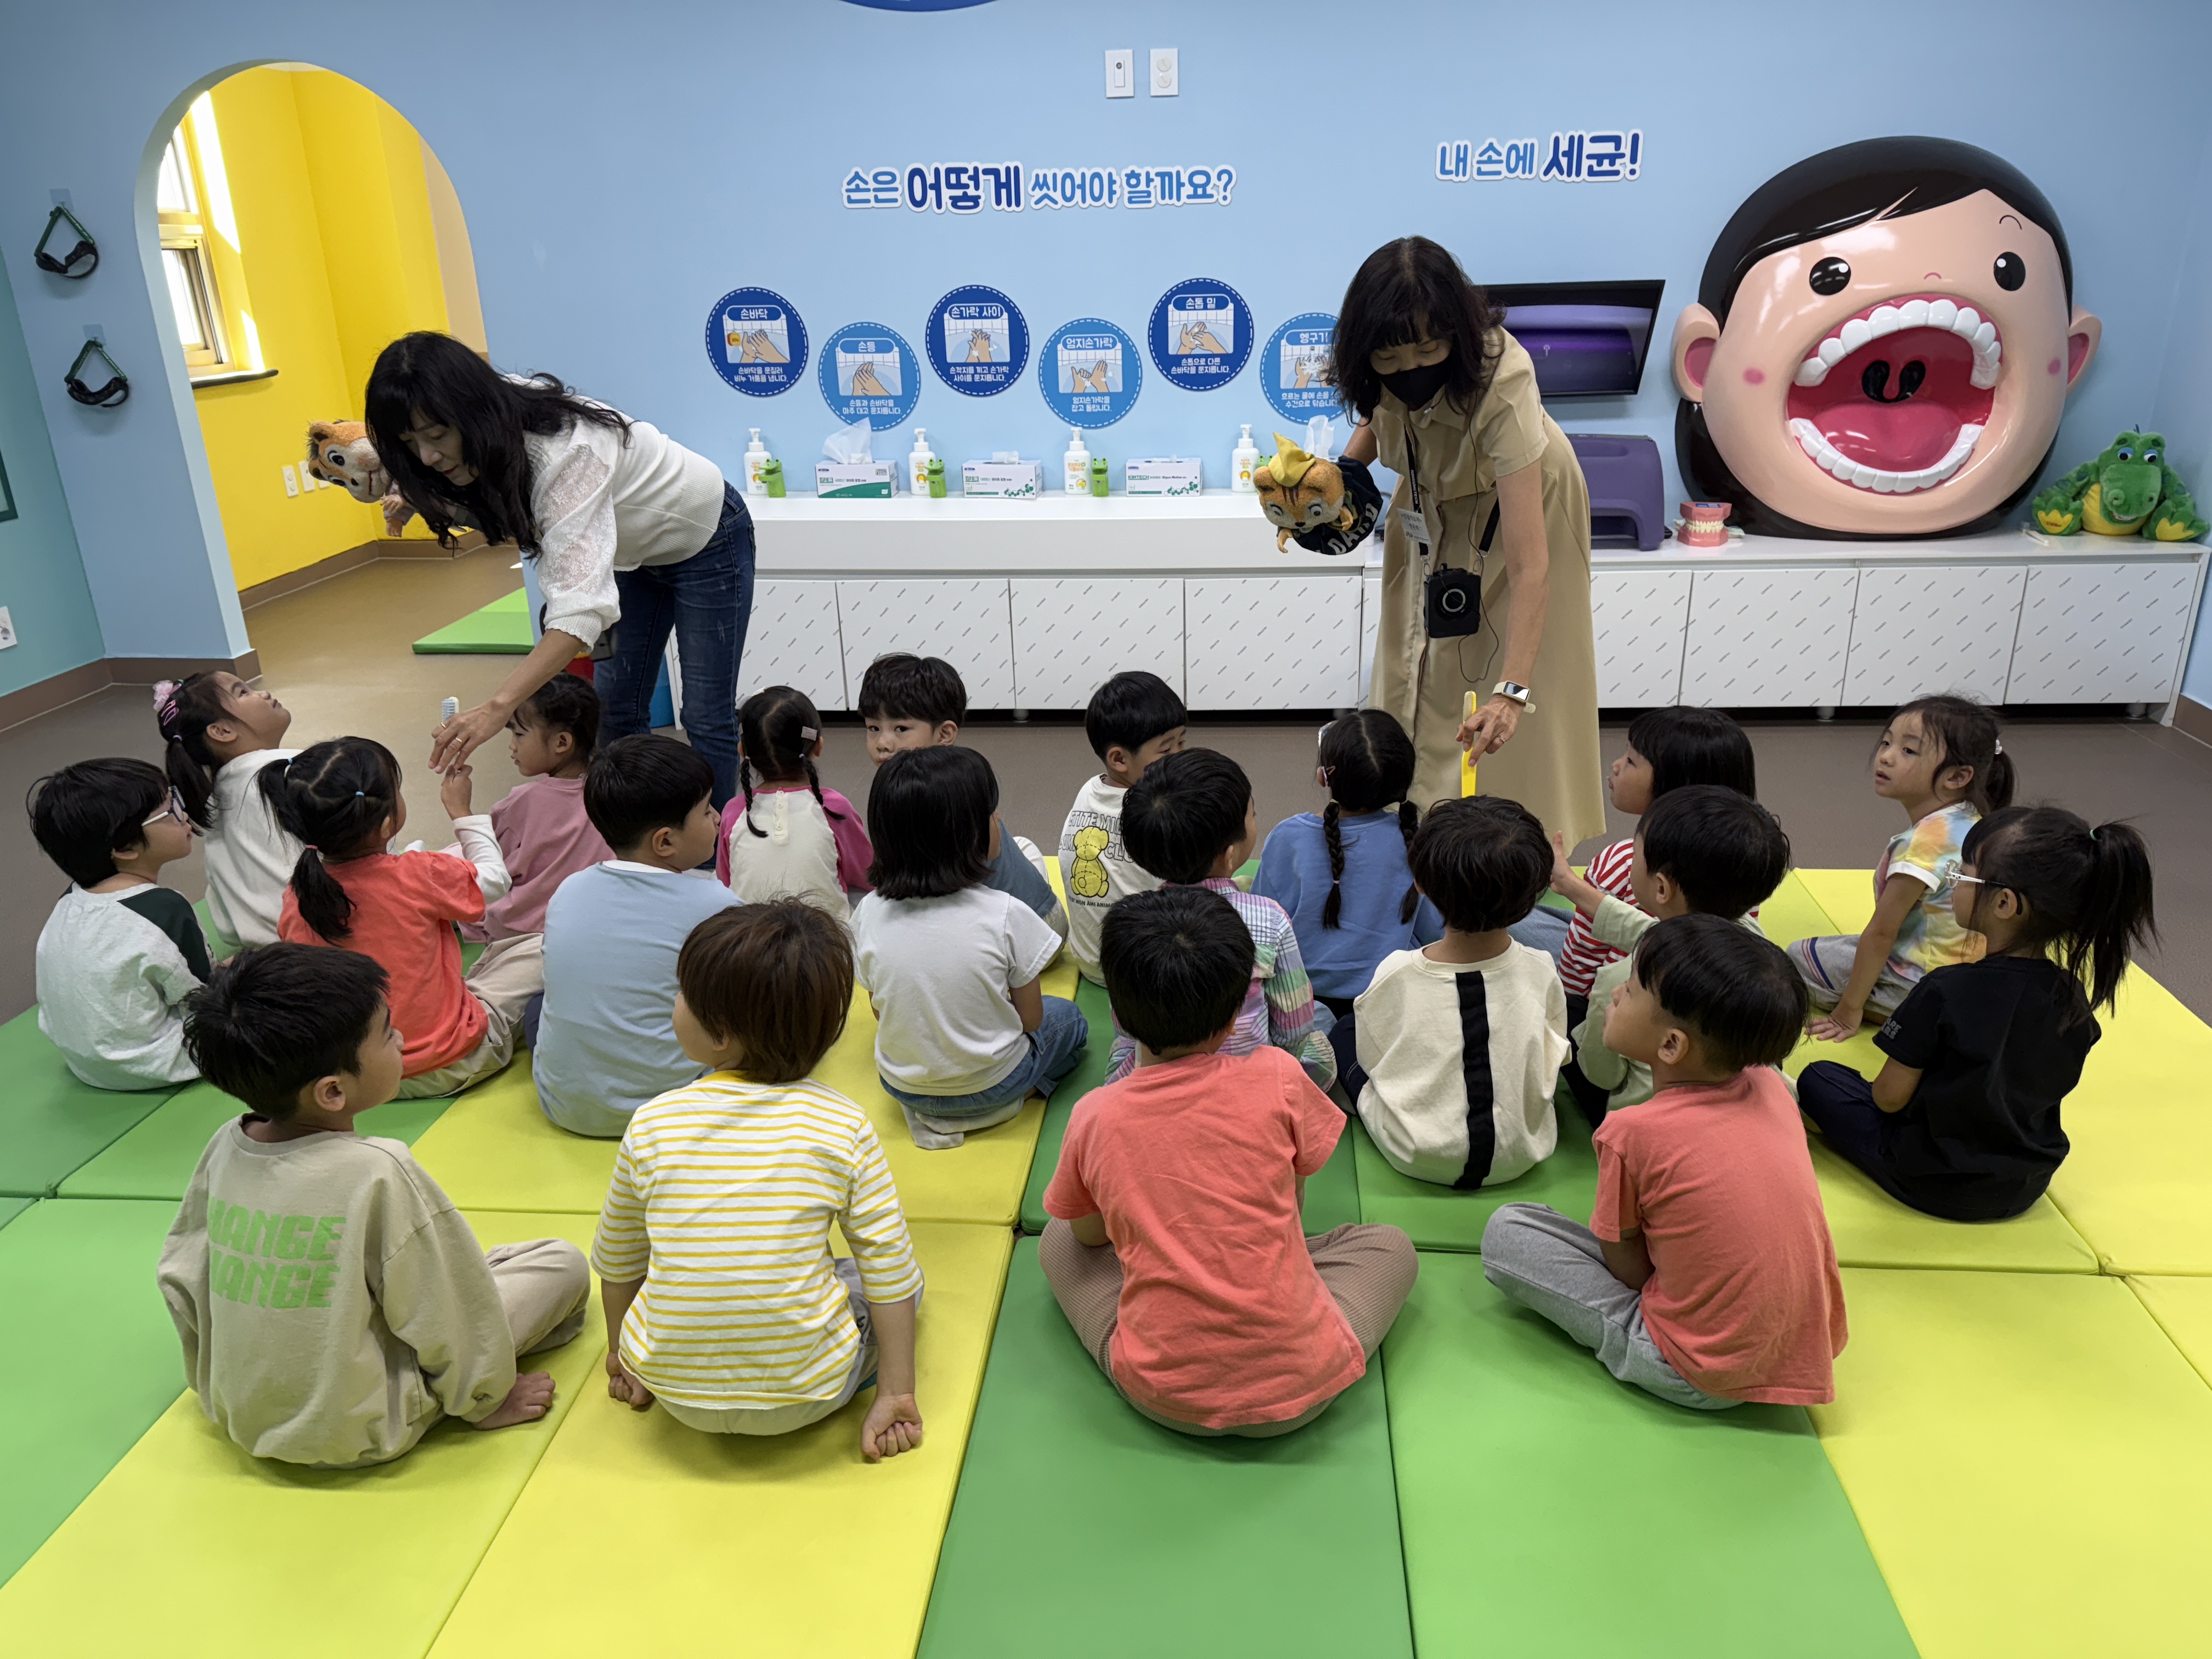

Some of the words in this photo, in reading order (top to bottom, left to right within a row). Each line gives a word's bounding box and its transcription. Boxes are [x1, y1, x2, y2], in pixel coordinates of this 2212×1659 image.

[1439, 143, 1469, 177] 내
[1476, 141, 1535, 177] 손에
[1543, 132, 1640, 178] 세균!
[844, 167, 900, 205] 손은
[906, 165, 1022, 210] 어떻게
[1031, 171, 1118, 206] 씻어야
[1124, 168, 1234, 204] 할까요?
[1186, 297, 1204, 309] 손톱
[741, 308, 768, 319] 손바닥
[951, 306, 979, 318] 손가락
[982, 306, 1001, 317] 사이
[1066, 337, 1113, 348] 엄지손가락
[1299, 332, 1328, 343] 헹구기
[857, 341, 876, 352] 손등
[950, 366, 974, 374] 손깍지를
[1171, 365, 1197, 374] 손바닥을
[1282, 392, 1300, 400] 흐르는
[1285, 400, 1311, 408] 수건으로
[1068, 810, 1098, 827] ETITE
